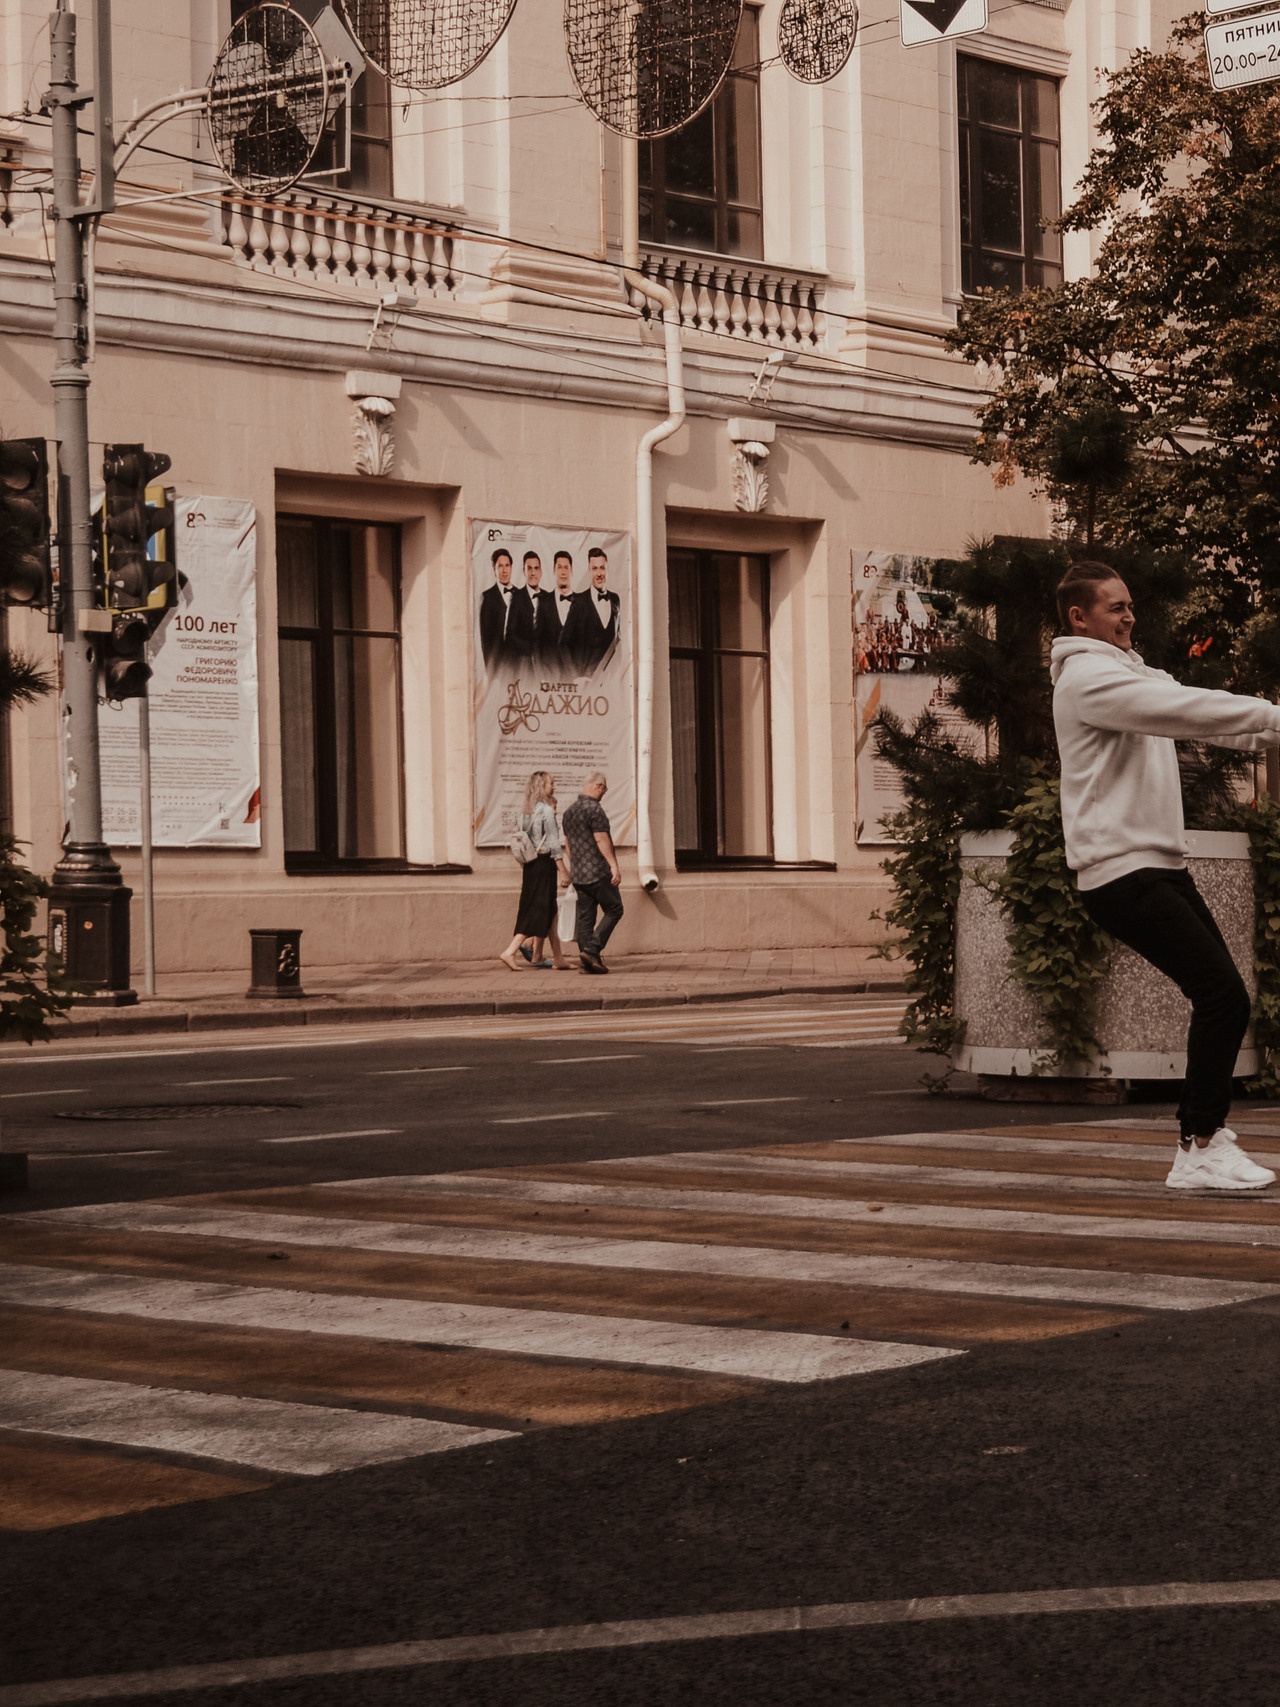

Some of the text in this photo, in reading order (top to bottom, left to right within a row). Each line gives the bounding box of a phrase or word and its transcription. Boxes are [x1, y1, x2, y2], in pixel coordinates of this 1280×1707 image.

[174, 614, 238, 634] 100 лет
[176, 637, 213, 645] НАРОДНОМУ
[195, 656, 238, 667] ГРИГОРИЮ
[184, 666, 237, 676] ФЕДОРОВИЧУ
[176, 674, 239, 686] ПОНОМАРЕНКО
[540, 682, 578, 693] КВАРТЕТ
